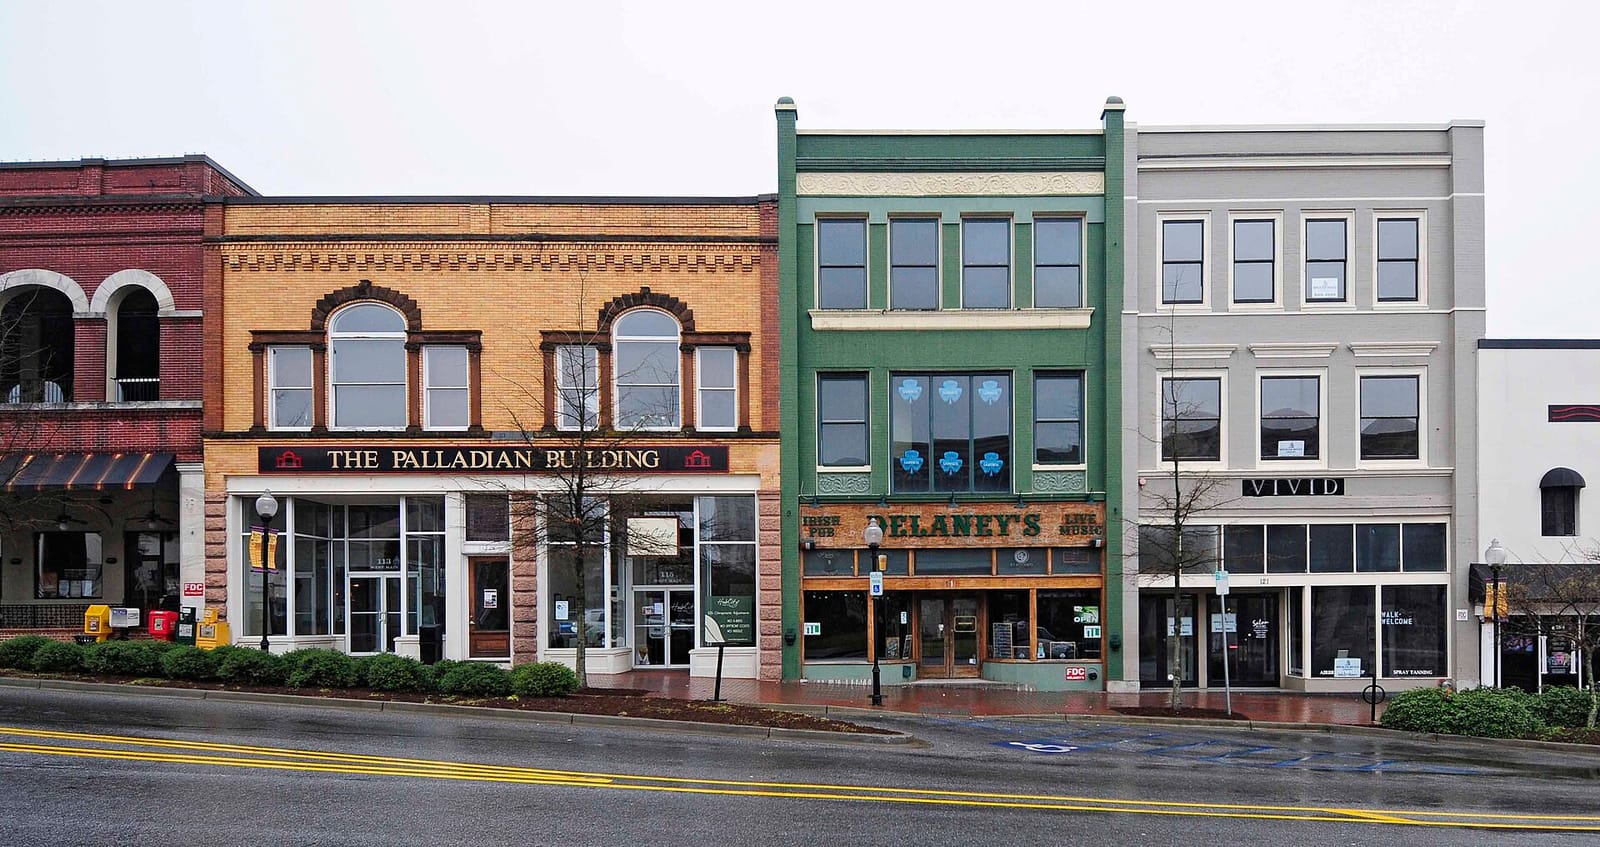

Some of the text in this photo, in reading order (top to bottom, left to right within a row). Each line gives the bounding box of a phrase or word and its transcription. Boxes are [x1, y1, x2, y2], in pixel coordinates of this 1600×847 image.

[327, 450, 660, 469] THE PALLADIAN BULDING
[1250, 479, 1339, 495] VIVID
[802, 516, 841, 526] IRISH
[1064, 514, 1097, 525] LIVE
[867, 514, 1040, 537] DELANEY'S
[1059, 525, 1103, 536] MUSIC
[809, 528, 835, 538] PUB
[184, 583, 203, 591] FDC
[1066, 668, 1085, 676] FDC
